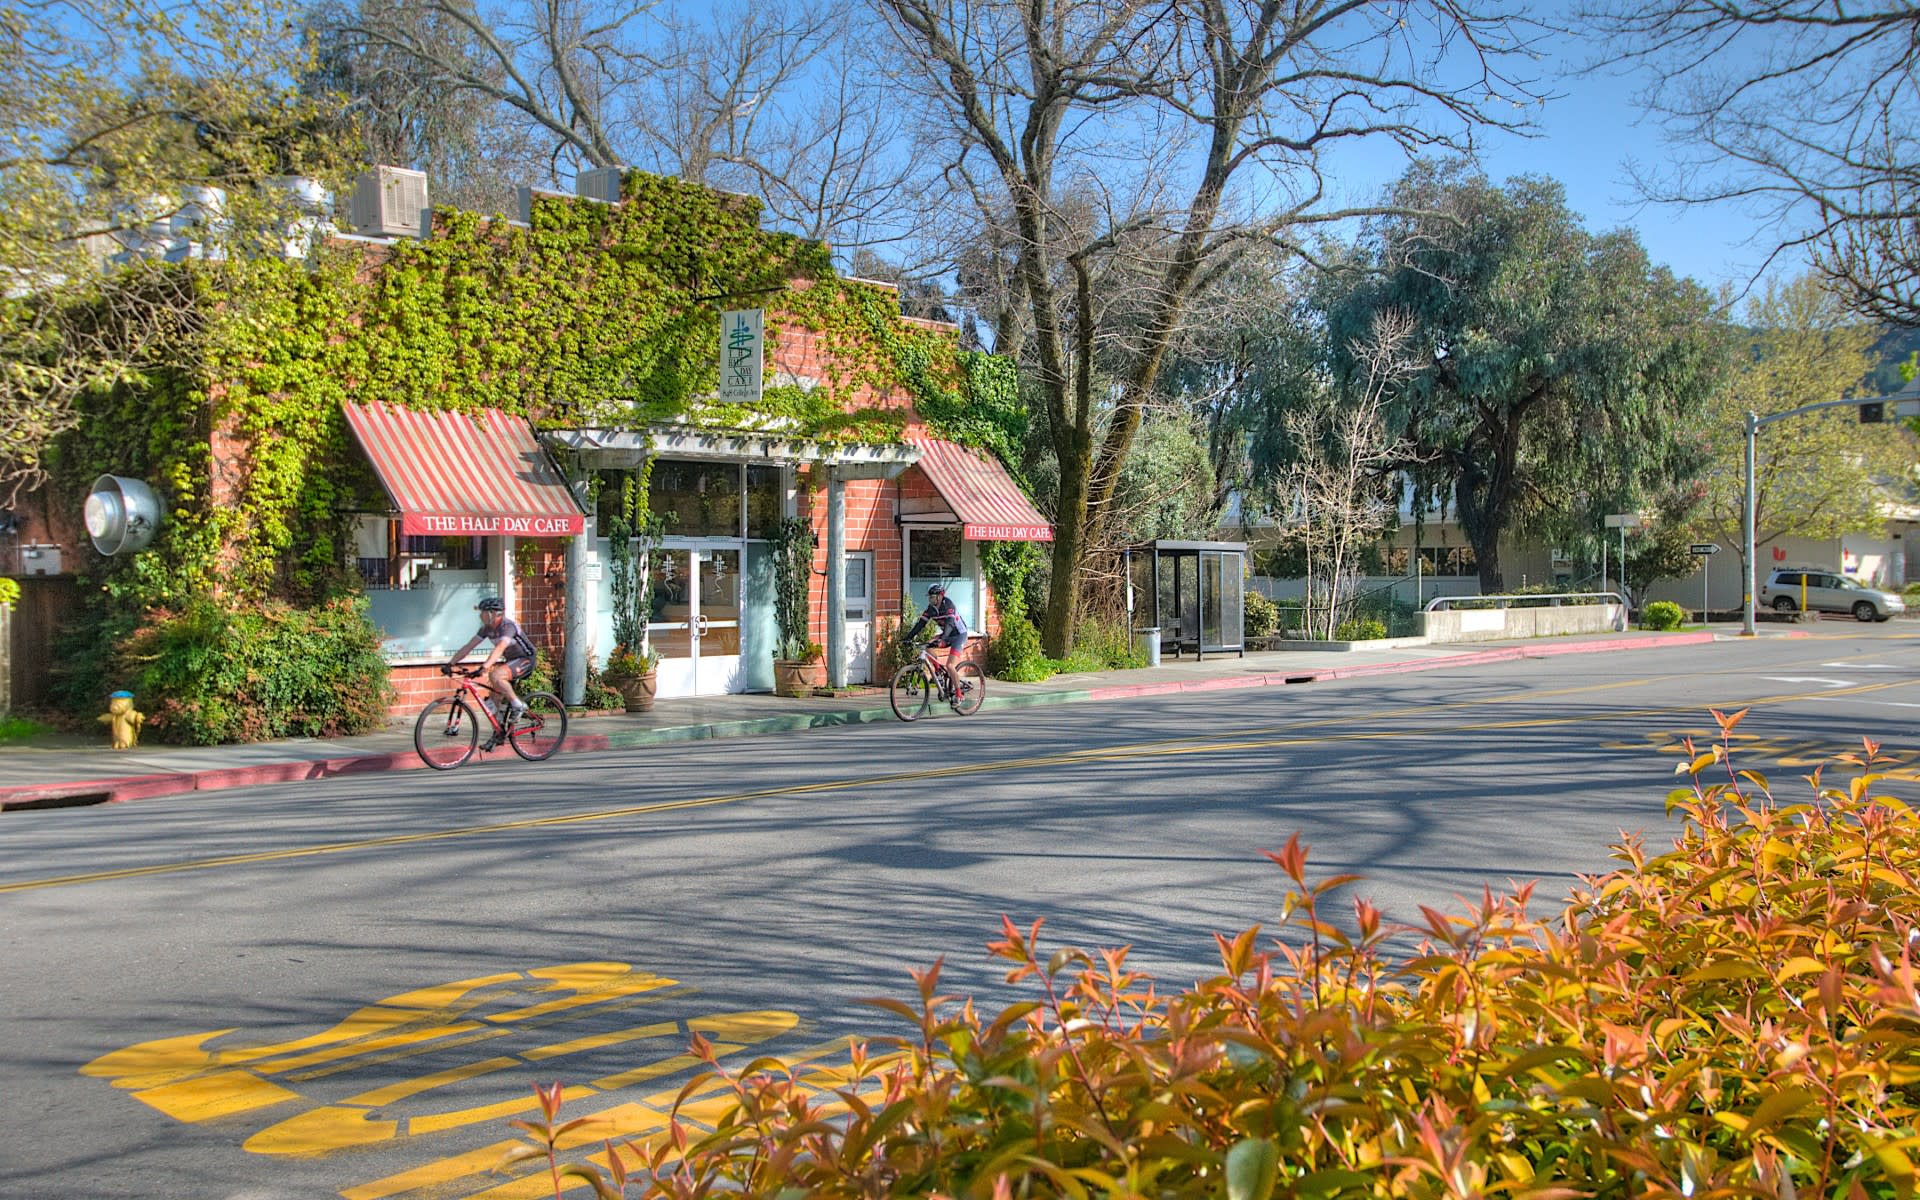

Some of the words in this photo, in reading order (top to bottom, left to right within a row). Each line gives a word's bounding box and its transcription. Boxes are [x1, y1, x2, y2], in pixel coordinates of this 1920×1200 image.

[422, 516, 457, 531] THE
[460, 516, 500, 532] HALF
[503, 517, 531, 532] DAY
[534, 518, 570, 533] CAFE
[967, 525, 987, 537] THE
[988, 526, 1011, 538] HALF
[1012, 527, 1028, 538] DAY
[1029, 527, 1051, 538] CAFE
